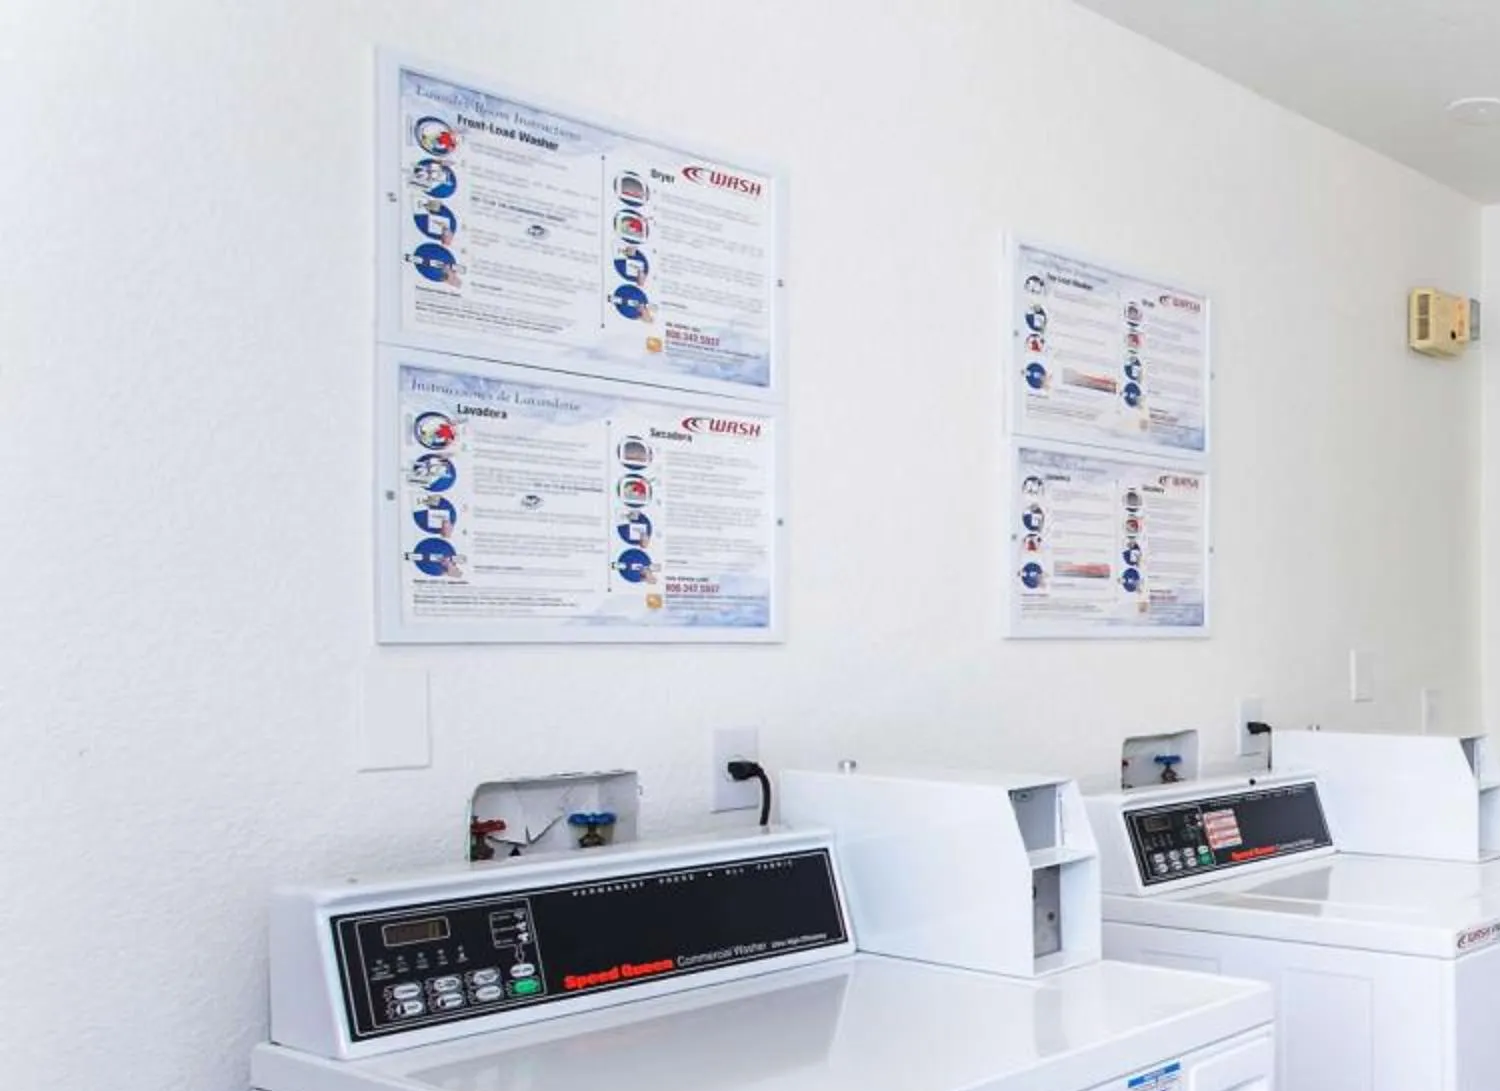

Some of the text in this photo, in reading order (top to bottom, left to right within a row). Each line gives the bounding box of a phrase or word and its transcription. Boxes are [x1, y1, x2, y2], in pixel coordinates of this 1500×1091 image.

[519, 131, 559, 151] Washer
[709, 171, 761, 196] WASH
[457, 403, 508, 420] Lavadora
[709, 418, 761, 438] WASH
[564, 966, 619, 989] Speed
[622, 959, 674, 977] Queen
[677, 946, 732, 967] Commercial
[733, 942, 767, 957] Washer
